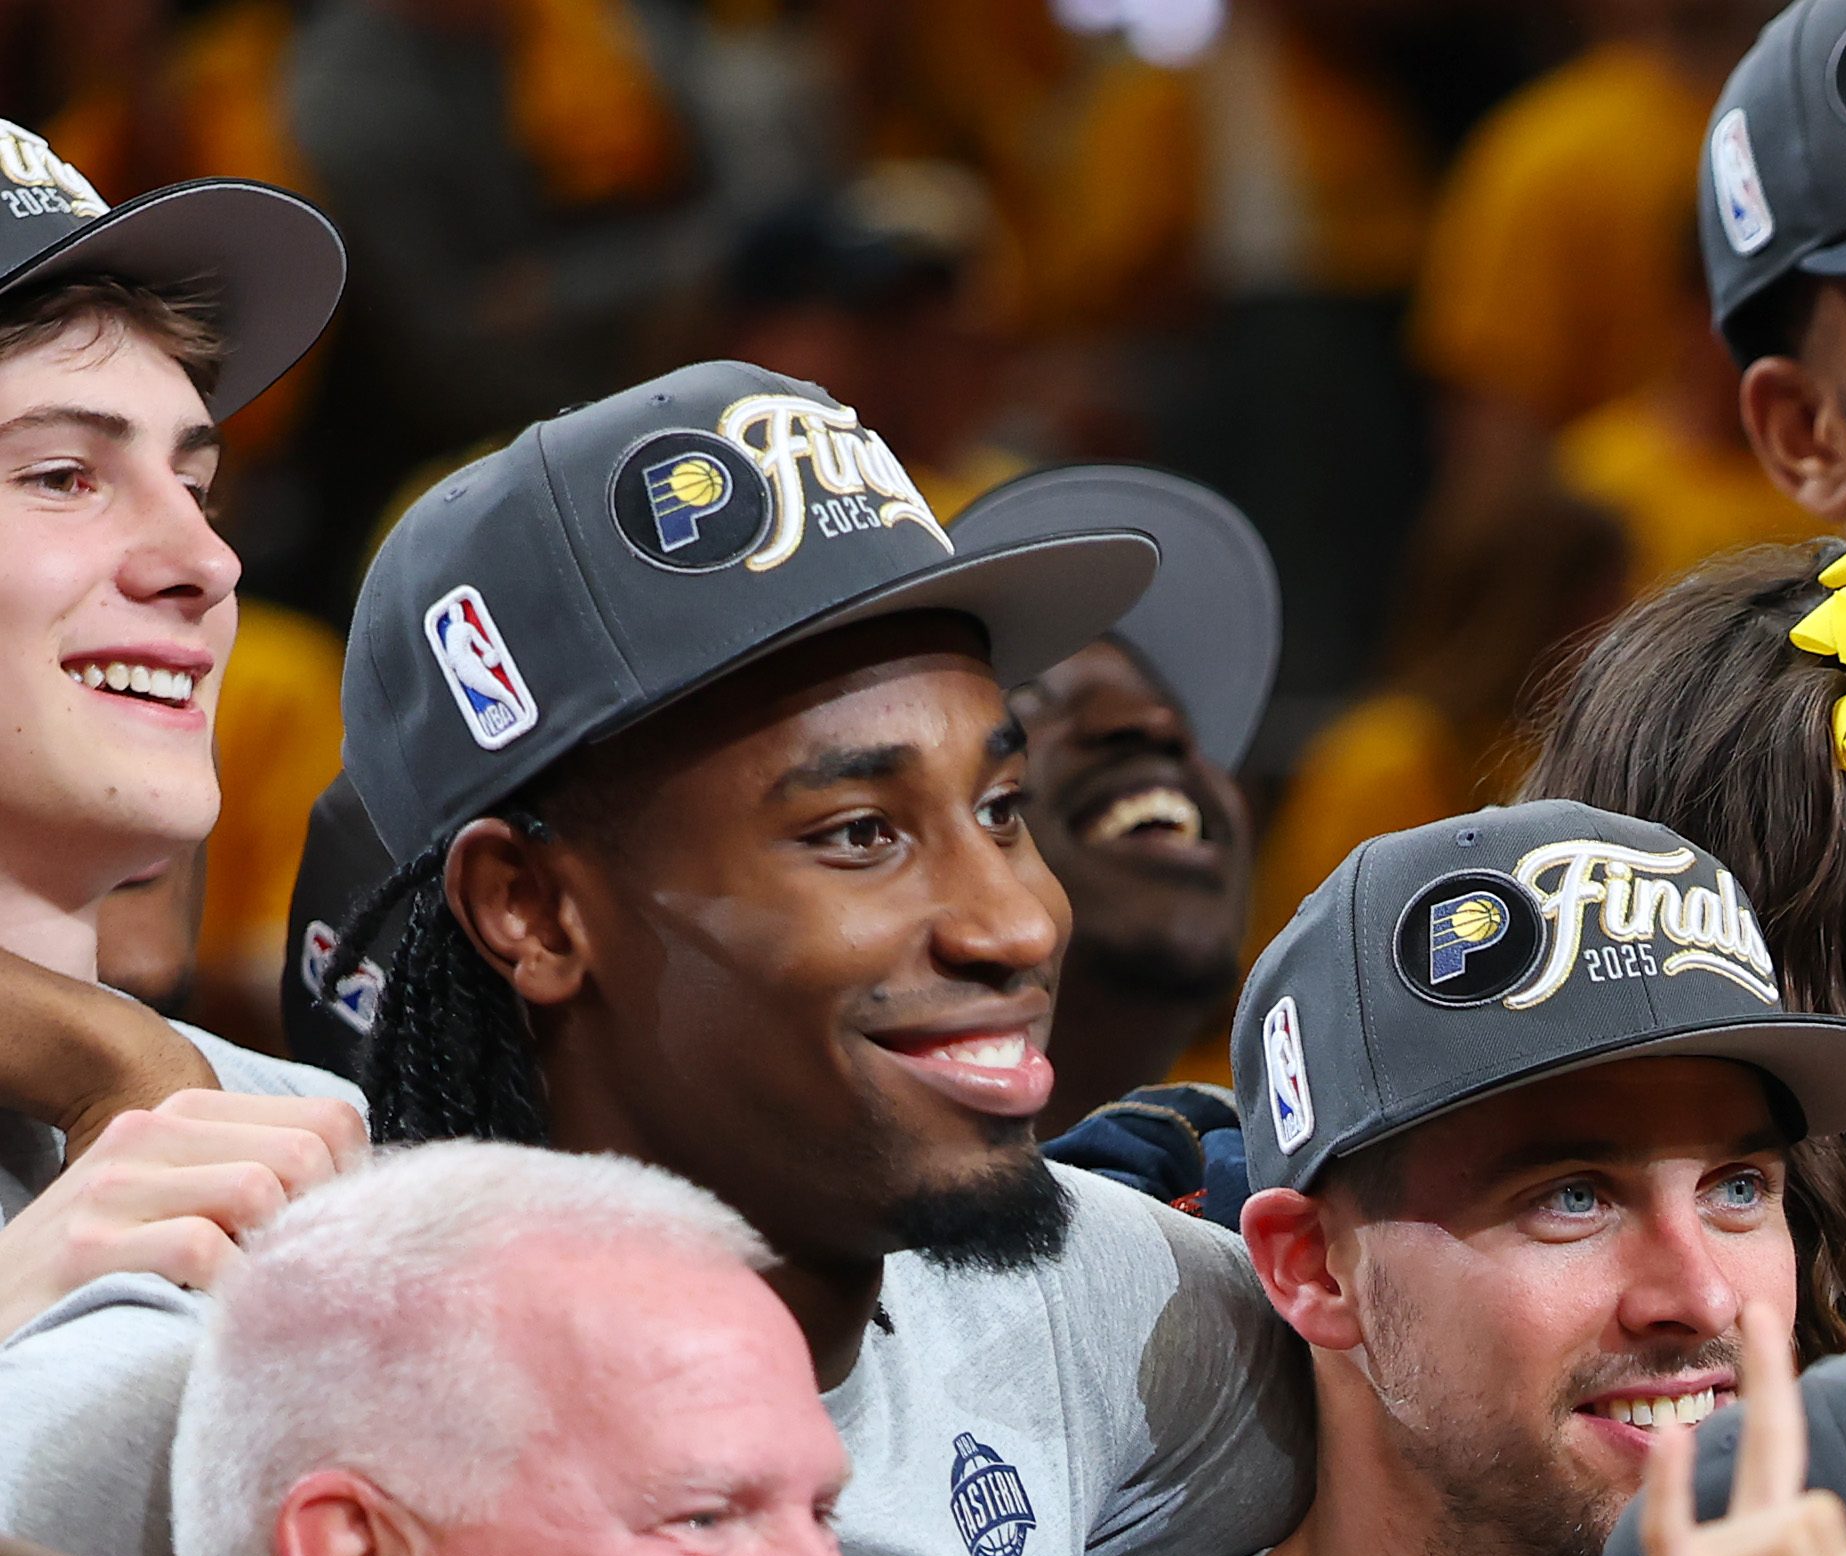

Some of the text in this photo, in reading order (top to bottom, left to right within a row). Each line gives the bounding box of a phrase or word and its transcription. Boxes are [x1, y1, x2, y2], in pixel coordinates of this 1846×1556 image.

[811, 494, 882, 538] 2025
[1584, 943, 1658, 983] 2025
[953, 1470, 1029, 1547] EASTERN
